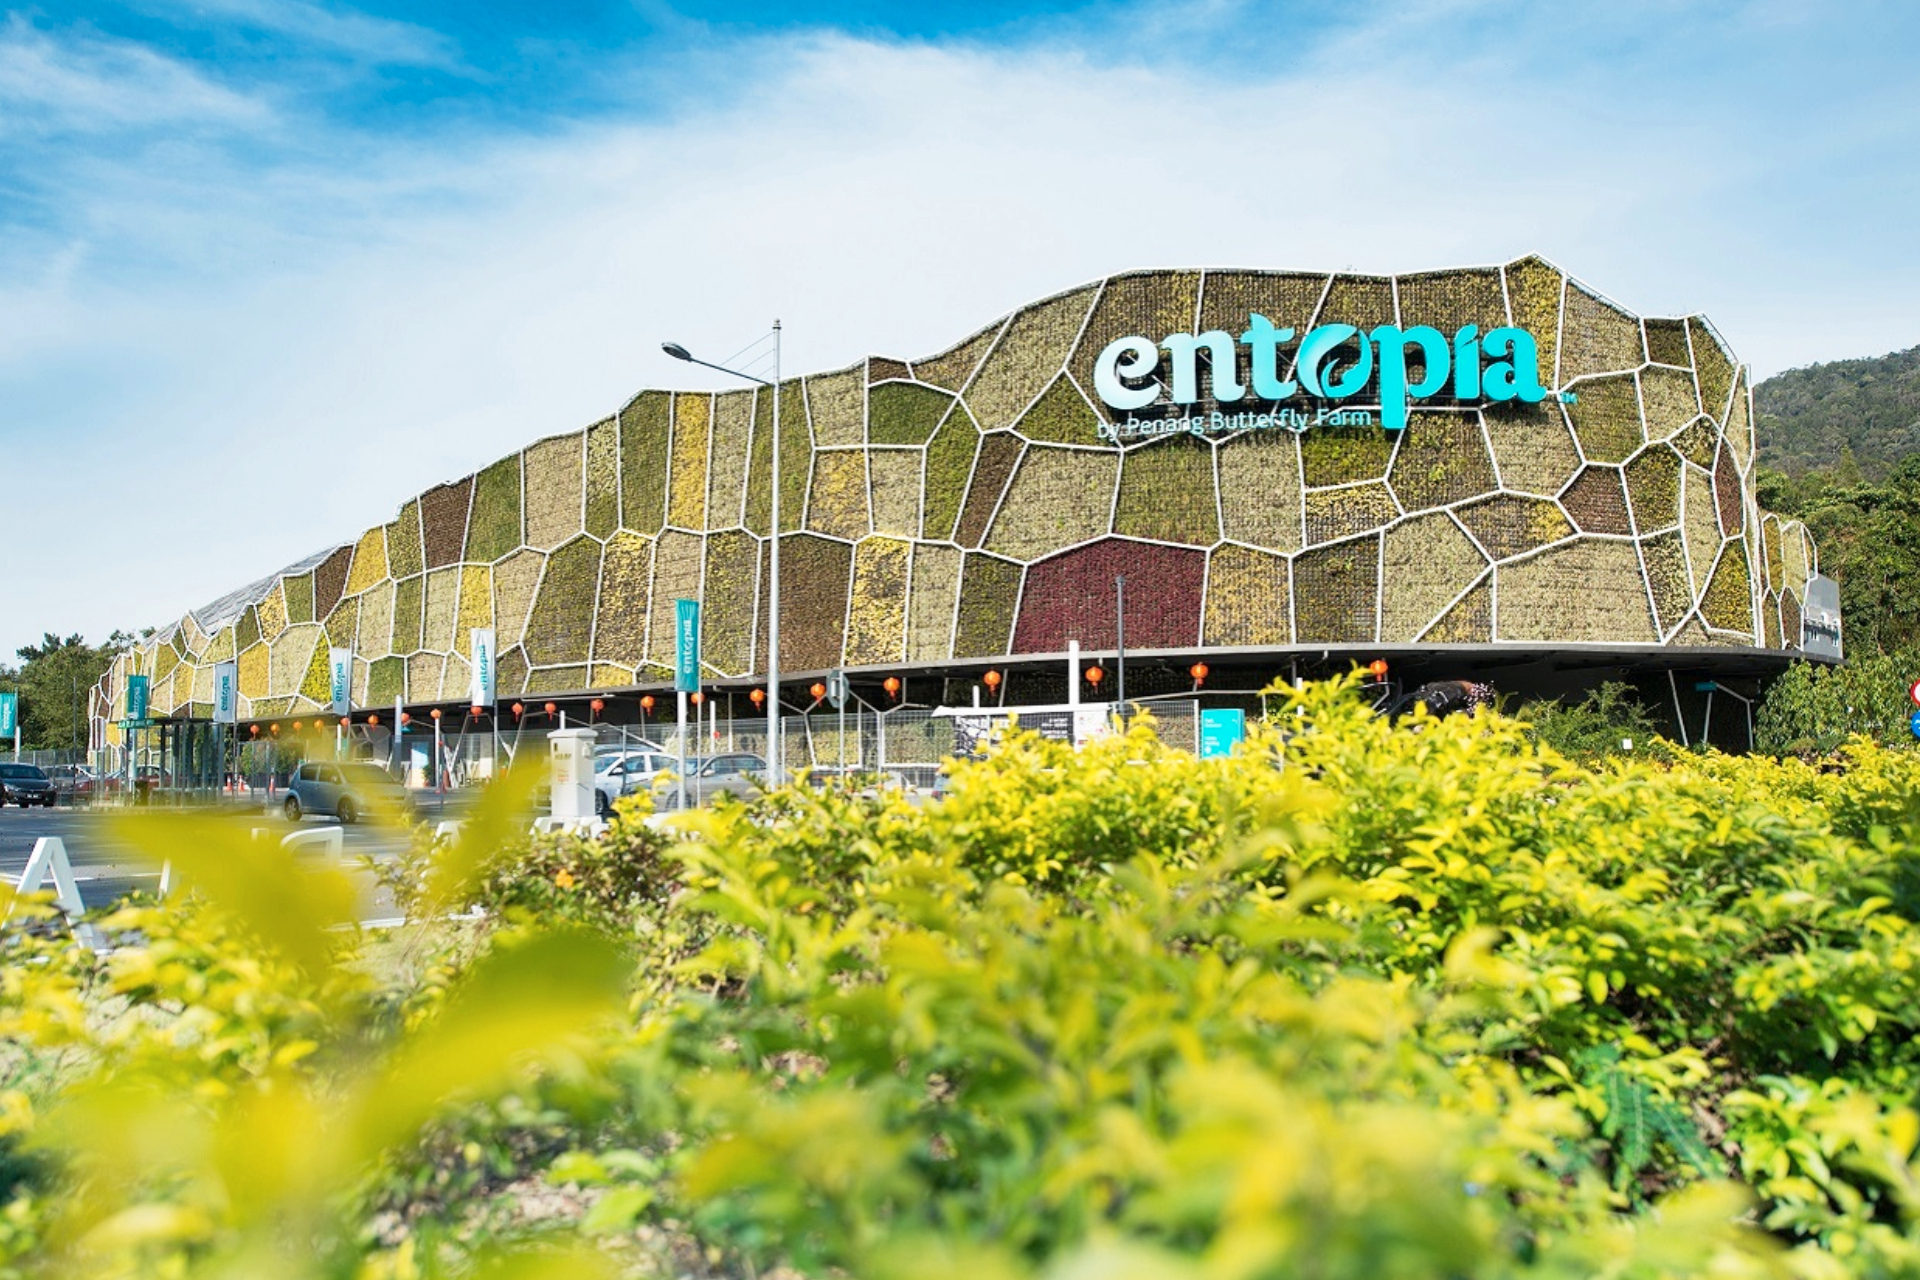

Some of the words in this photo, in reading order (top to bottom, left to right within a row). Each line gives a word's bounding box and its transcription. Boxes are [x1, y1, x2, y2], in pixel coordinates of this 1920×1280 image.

[1094, 313, 1547, 429] entopia
[1097, 421, 1120, 441] by
[1127, 416, 1204, 436] Penang
[1211, 409, 1308, 431] Butterfly
[1317, 408, 1372, 427] Farm
